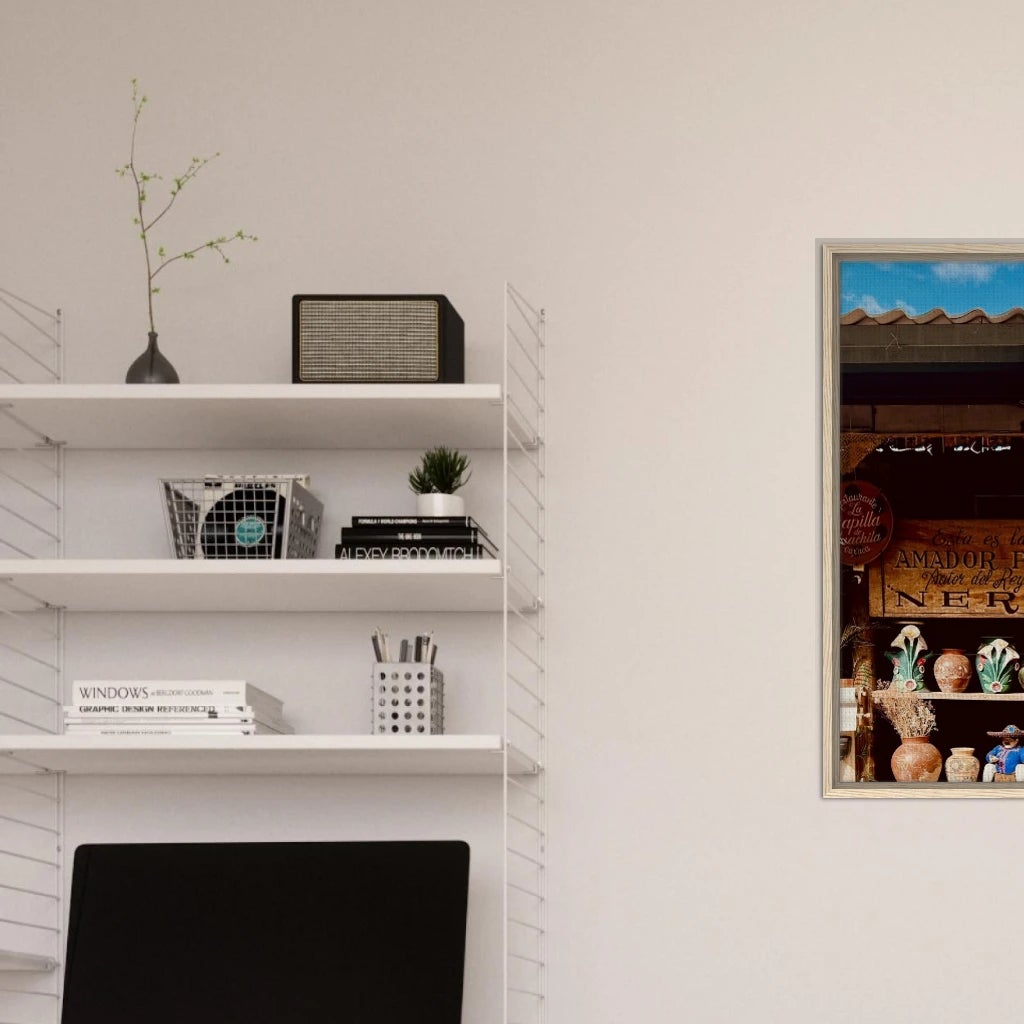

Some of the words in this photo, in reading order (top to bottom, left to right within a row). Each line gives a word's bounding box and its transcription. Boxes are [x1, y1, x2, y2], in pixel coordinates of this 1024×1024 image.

[931, 527, 973, 546] Esta
[983, 532, 1000, 548] es
[894, 549, 999, 571] AMADOR
[971, 568, 993, 586] del
[79, 687, 149, 699] WINDOWS
[79, 705, 119, 713] GRAPHIC
[122, 705, 155, 713] DESIGN
